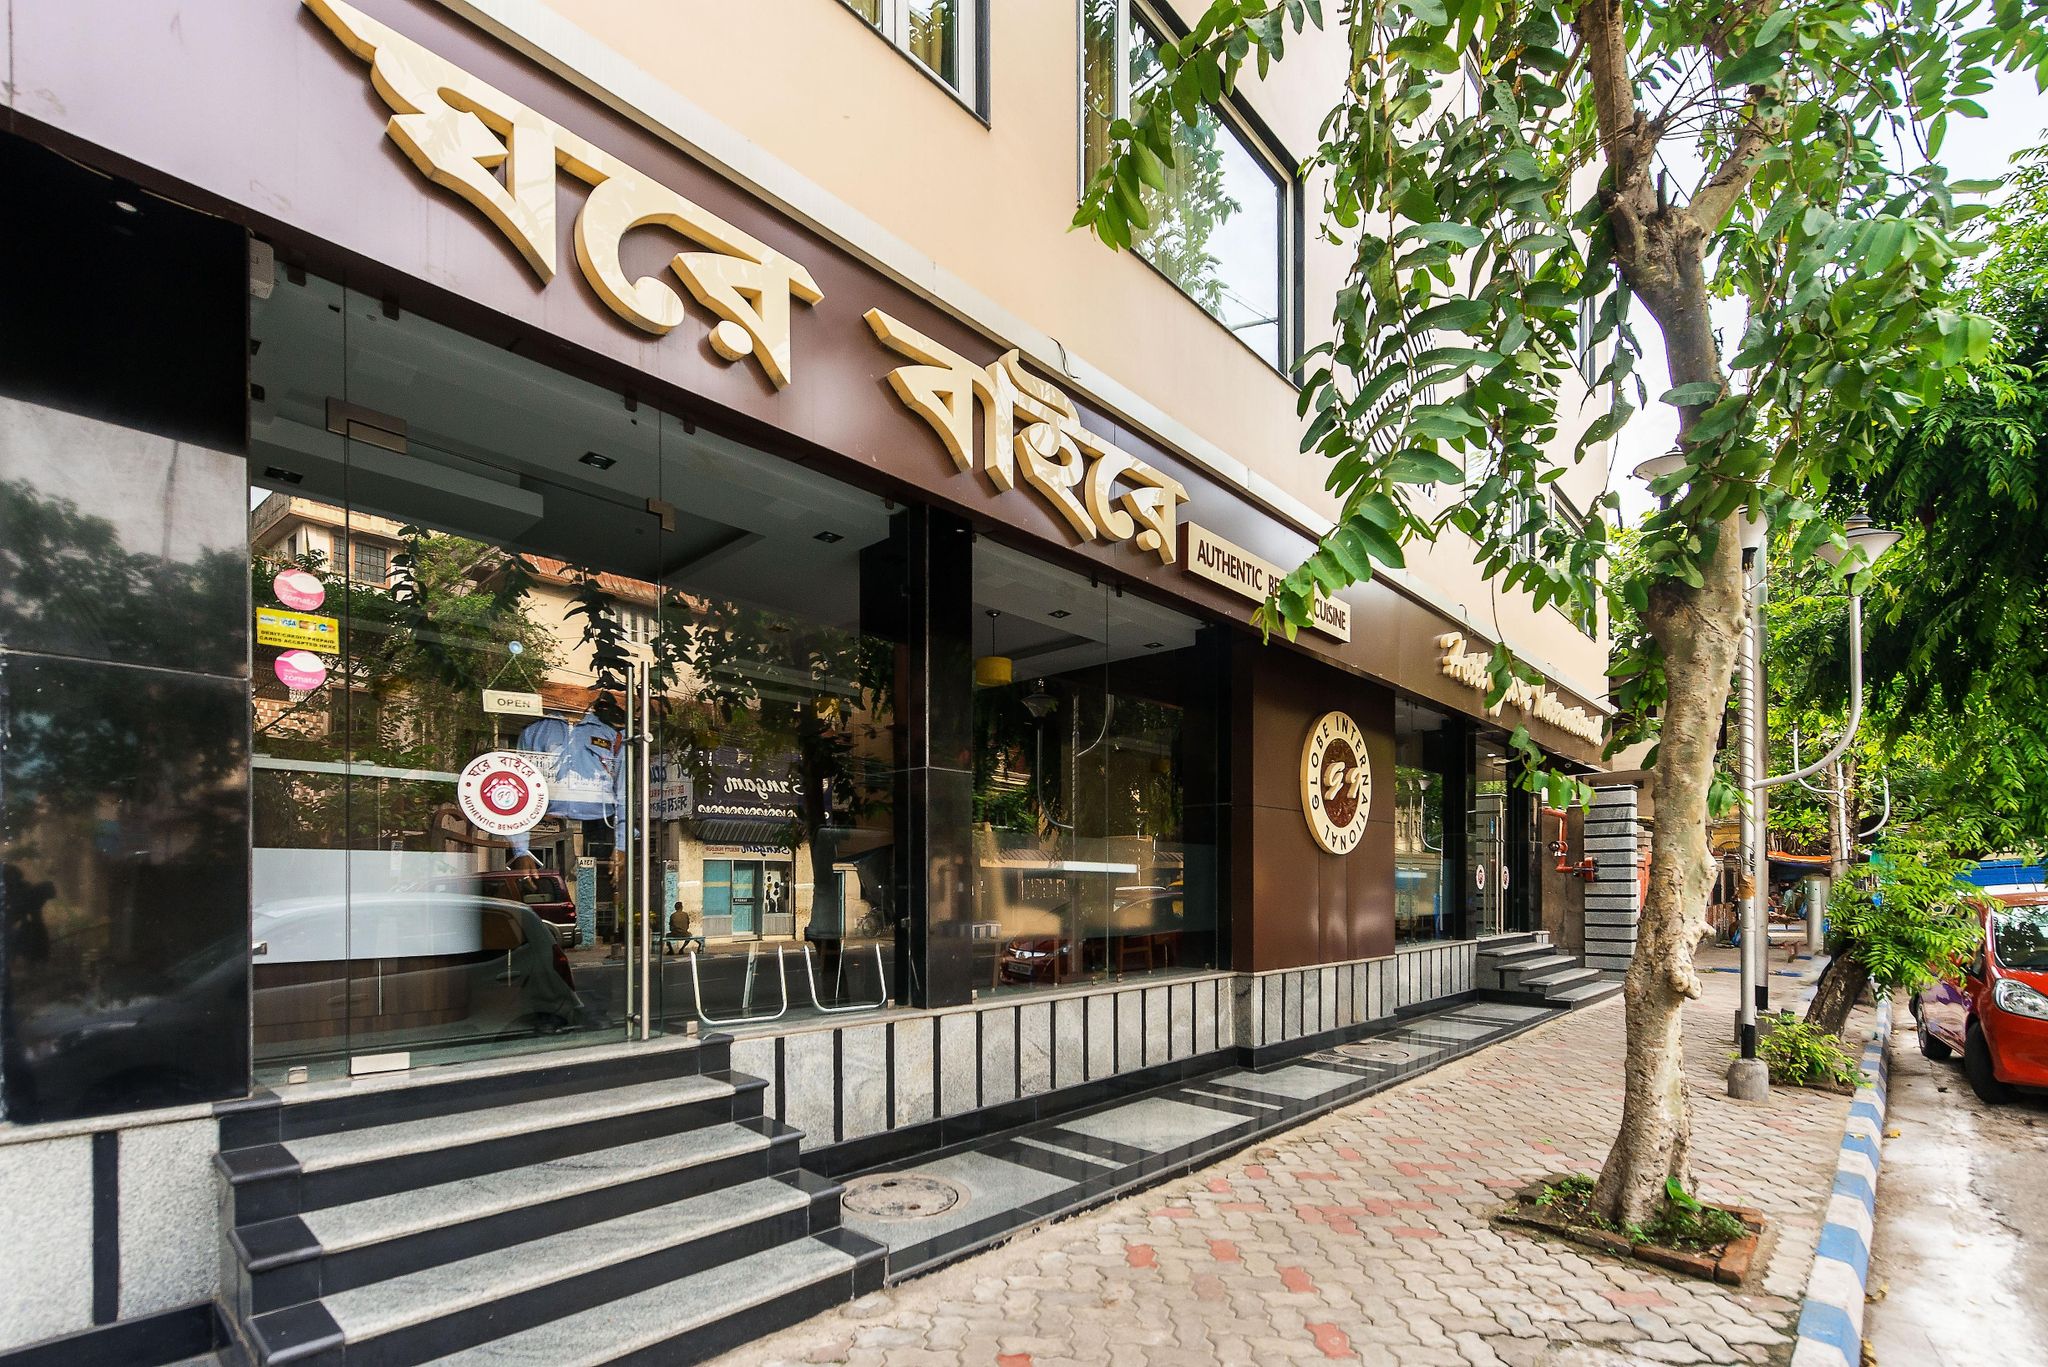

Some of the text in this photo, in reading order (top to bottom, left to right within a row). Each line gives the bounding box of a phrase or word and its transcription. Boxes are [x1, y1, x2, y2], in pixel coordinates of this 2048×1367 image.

[302, 0, 1190, 565] ঘরে বাইরে
[1197, 539, 1263, 591] AUTHENTIC
[1314, 598, 1346, 631] CUISINE
[497, 698, 531, 708] OPEN
[467, 756, 536, 778] ঘরে বাইরে
[1310, 716, 1369, 851] GLOBE INTERNATIONAL
[464, 794, 495, 828] AUTHENTIC
[497, 818, 531, 830] BENGALI
[529, 794, 545, 820] CUISINE
